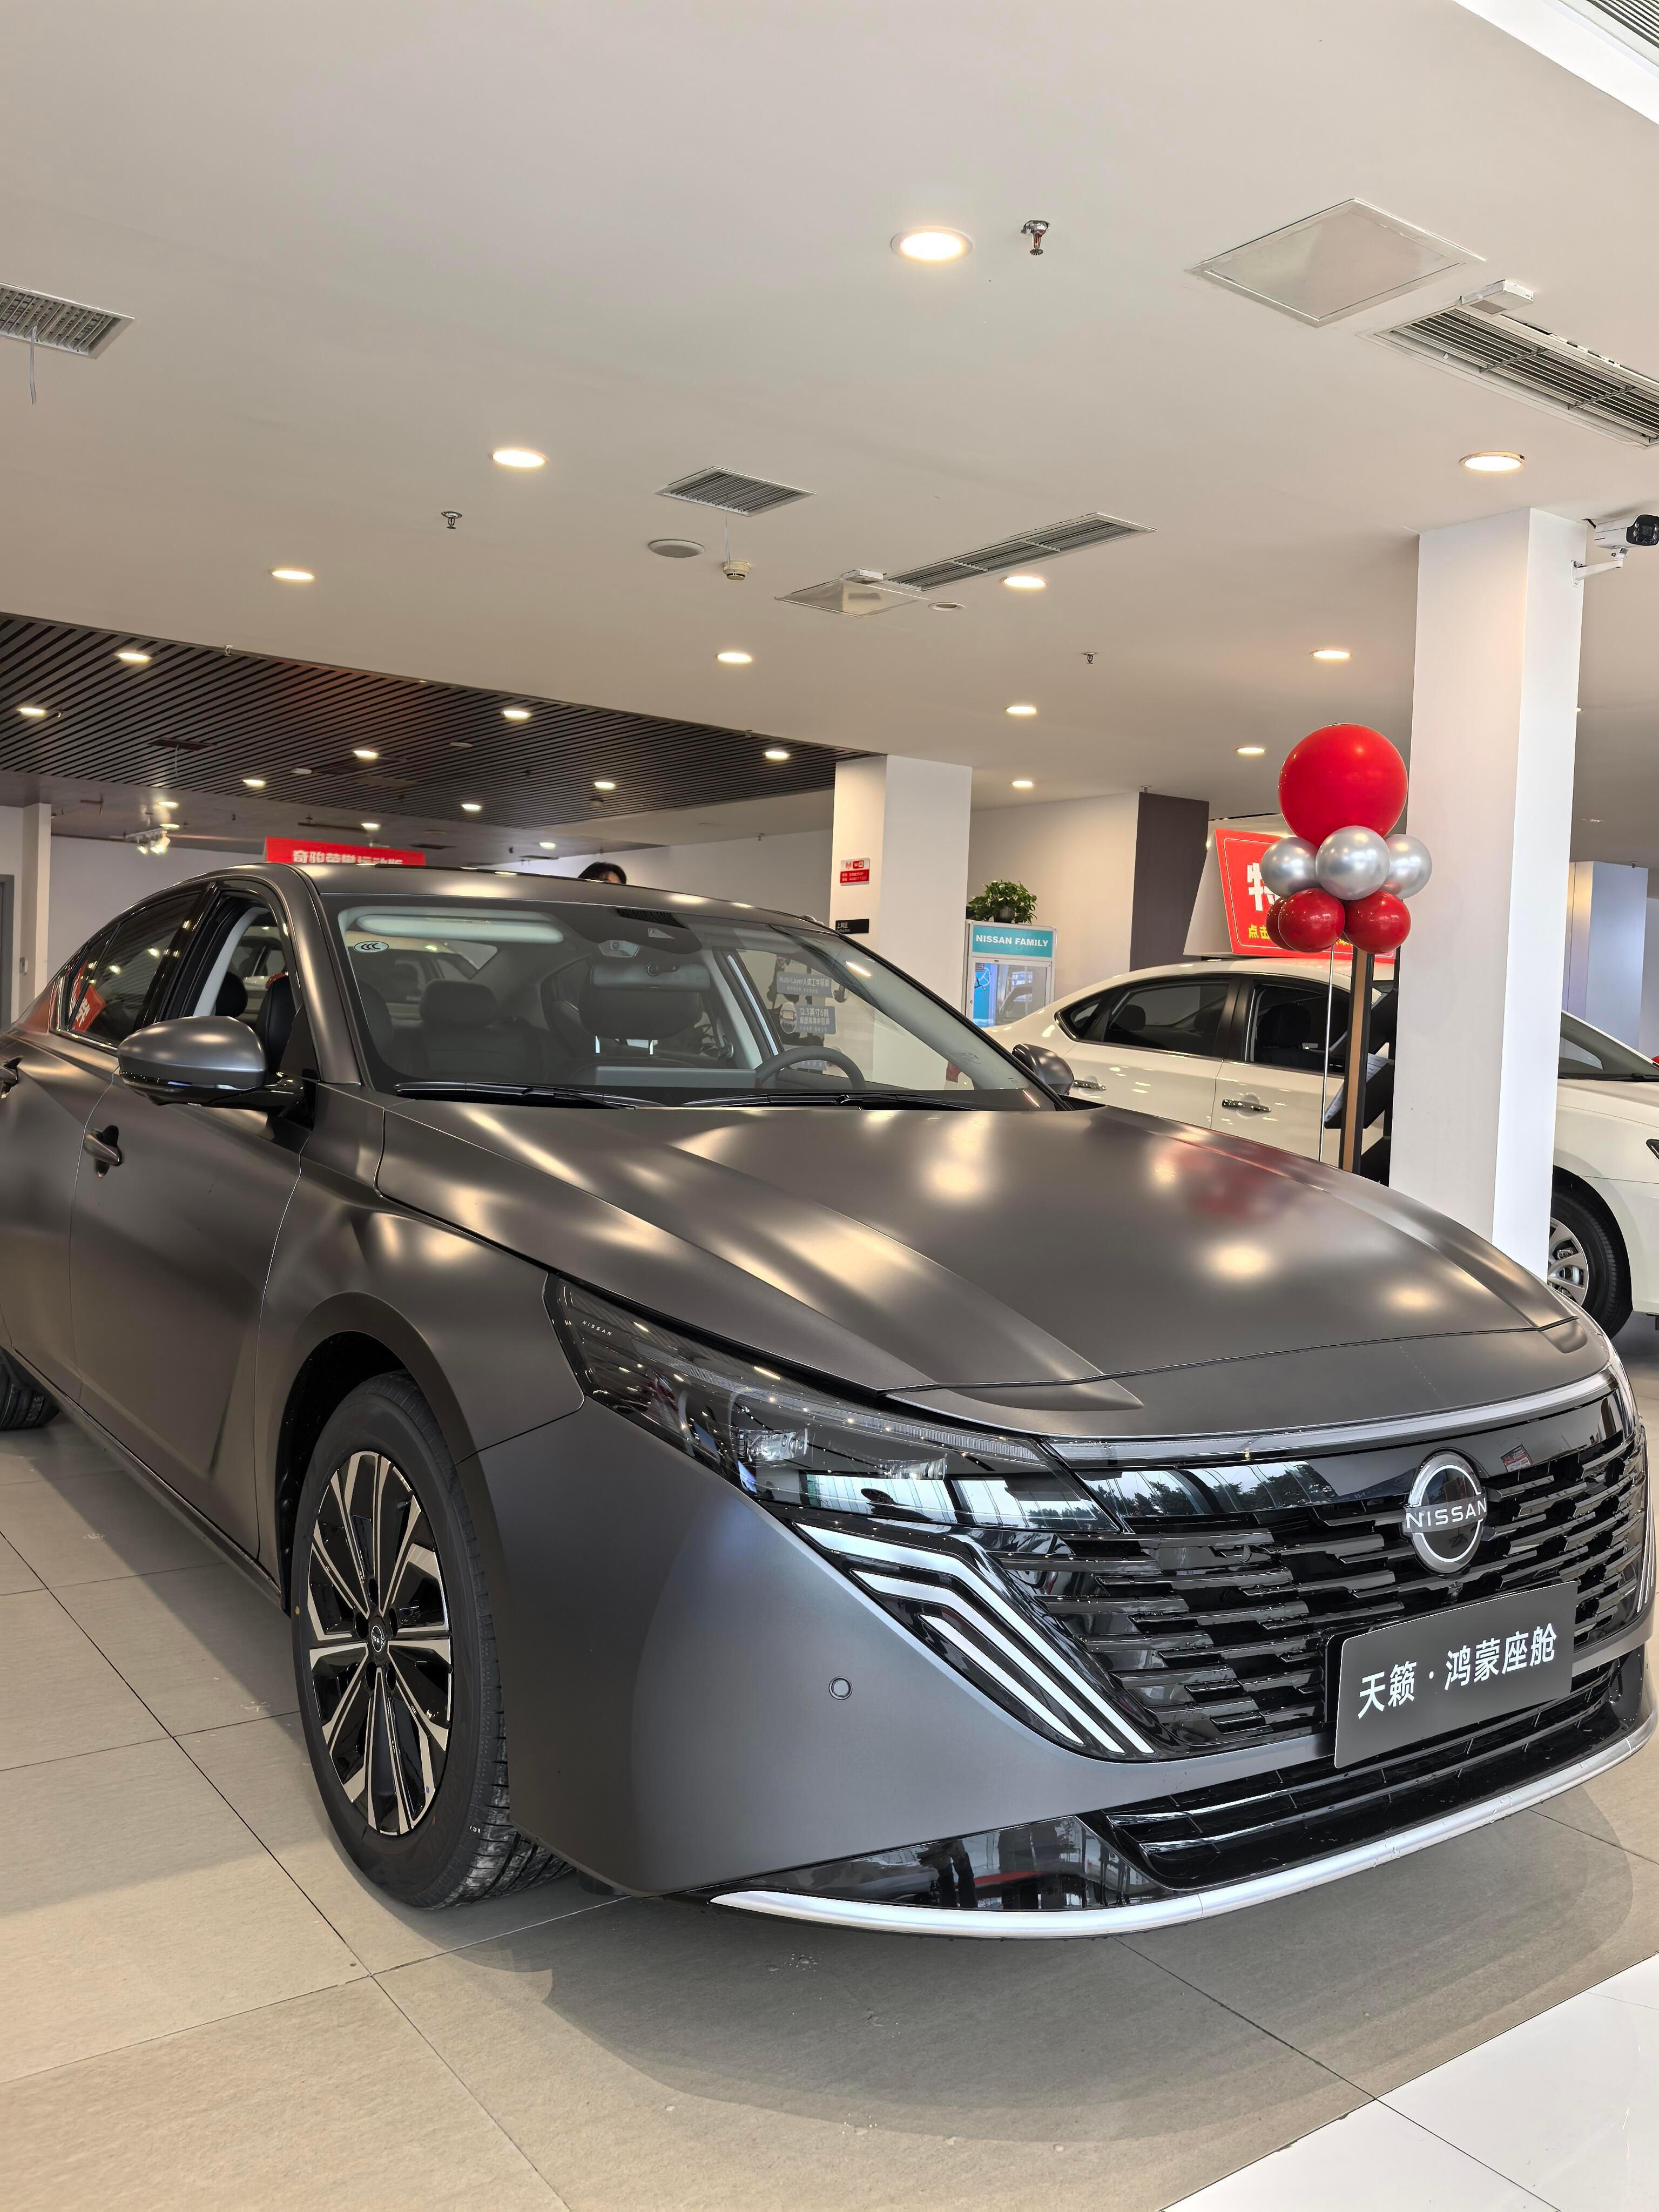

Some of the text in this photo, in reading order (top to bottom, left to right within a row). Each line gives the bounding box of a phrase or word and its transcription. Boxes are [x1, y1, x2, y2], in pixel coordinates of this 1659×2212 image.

[975, 935, 1049, 947] NISSAN FAMILY
[582, 1320, 612, 1336] NISSAN
[1406, 1497, 1487, 1529] NISSAN
